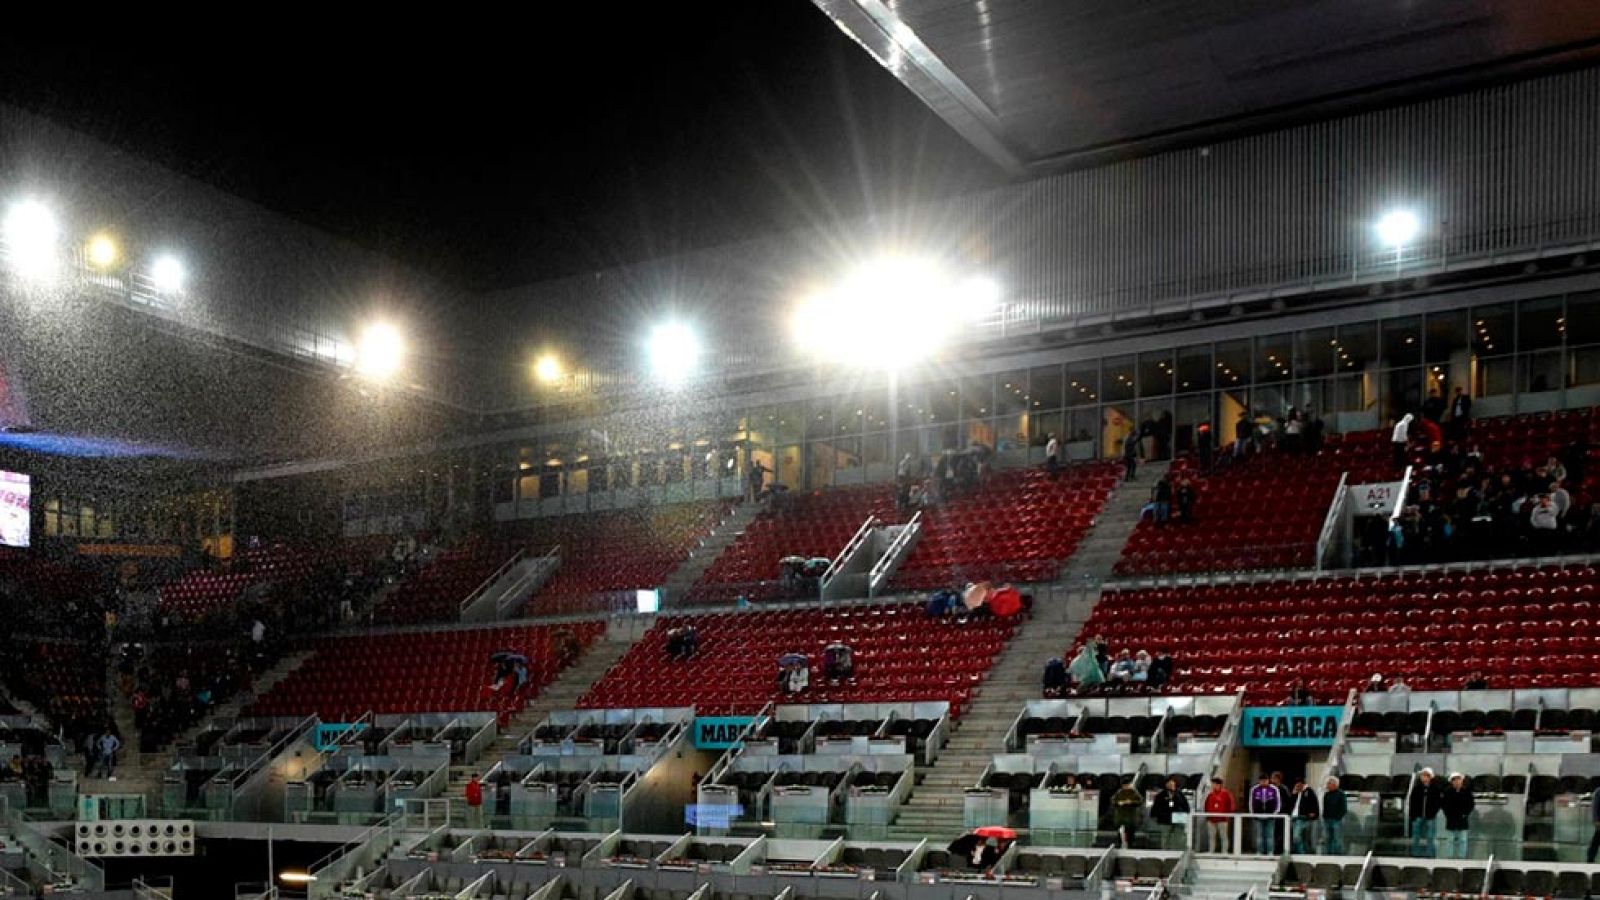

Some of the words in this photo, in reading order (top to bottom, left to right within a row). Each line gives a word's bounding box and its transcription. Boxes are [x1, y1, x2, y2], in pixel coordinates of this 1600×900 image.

[1367, 487, 1390, 500] A21
[701, 724, 758, 743] MAR
[1251, 716, 1338, 738] MARCA
